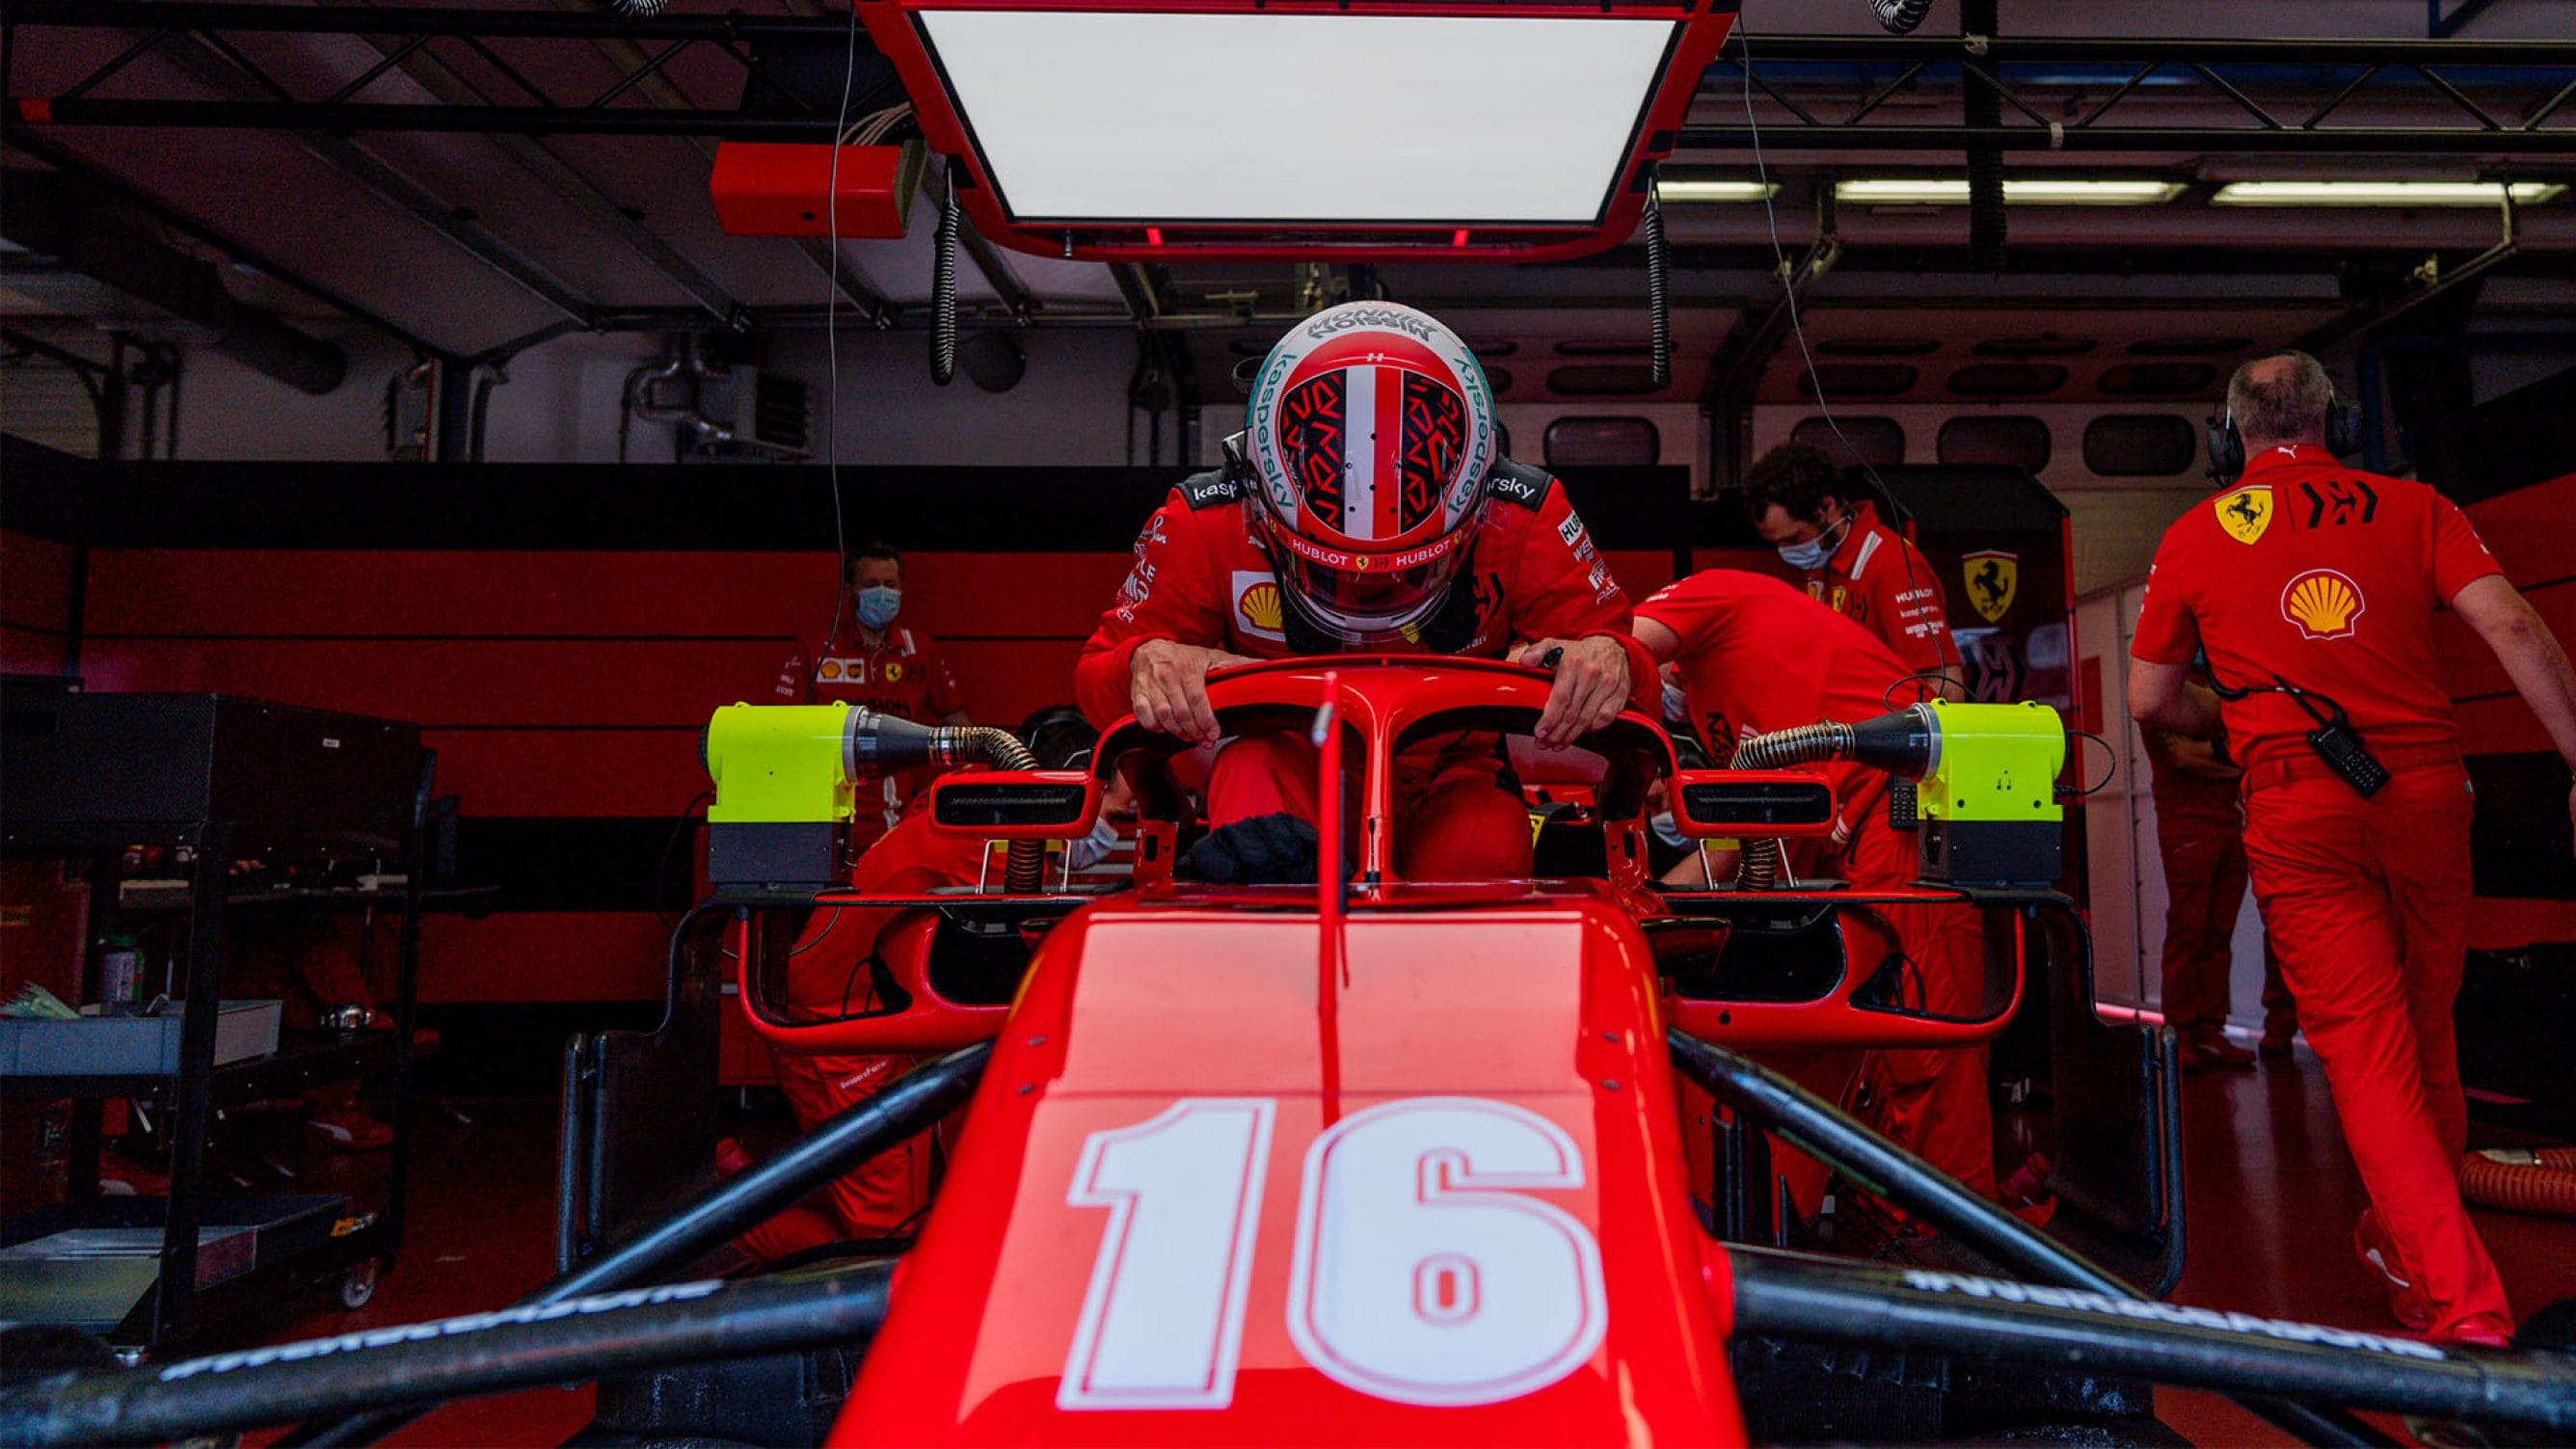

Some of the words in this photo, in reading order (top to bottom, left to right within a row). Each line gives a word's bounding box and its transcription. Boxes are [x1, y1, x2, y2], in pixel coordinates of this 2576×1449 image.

[1256, 352, 1298, 510] kaspersky
[1447, 357, 1488, 514] kaspersky
[1292, 538, 1349, 566] HUBLOT
[1396, 540, 1450, 566] HUBLOT
[1056, 1096, 1608, 1410] 16
